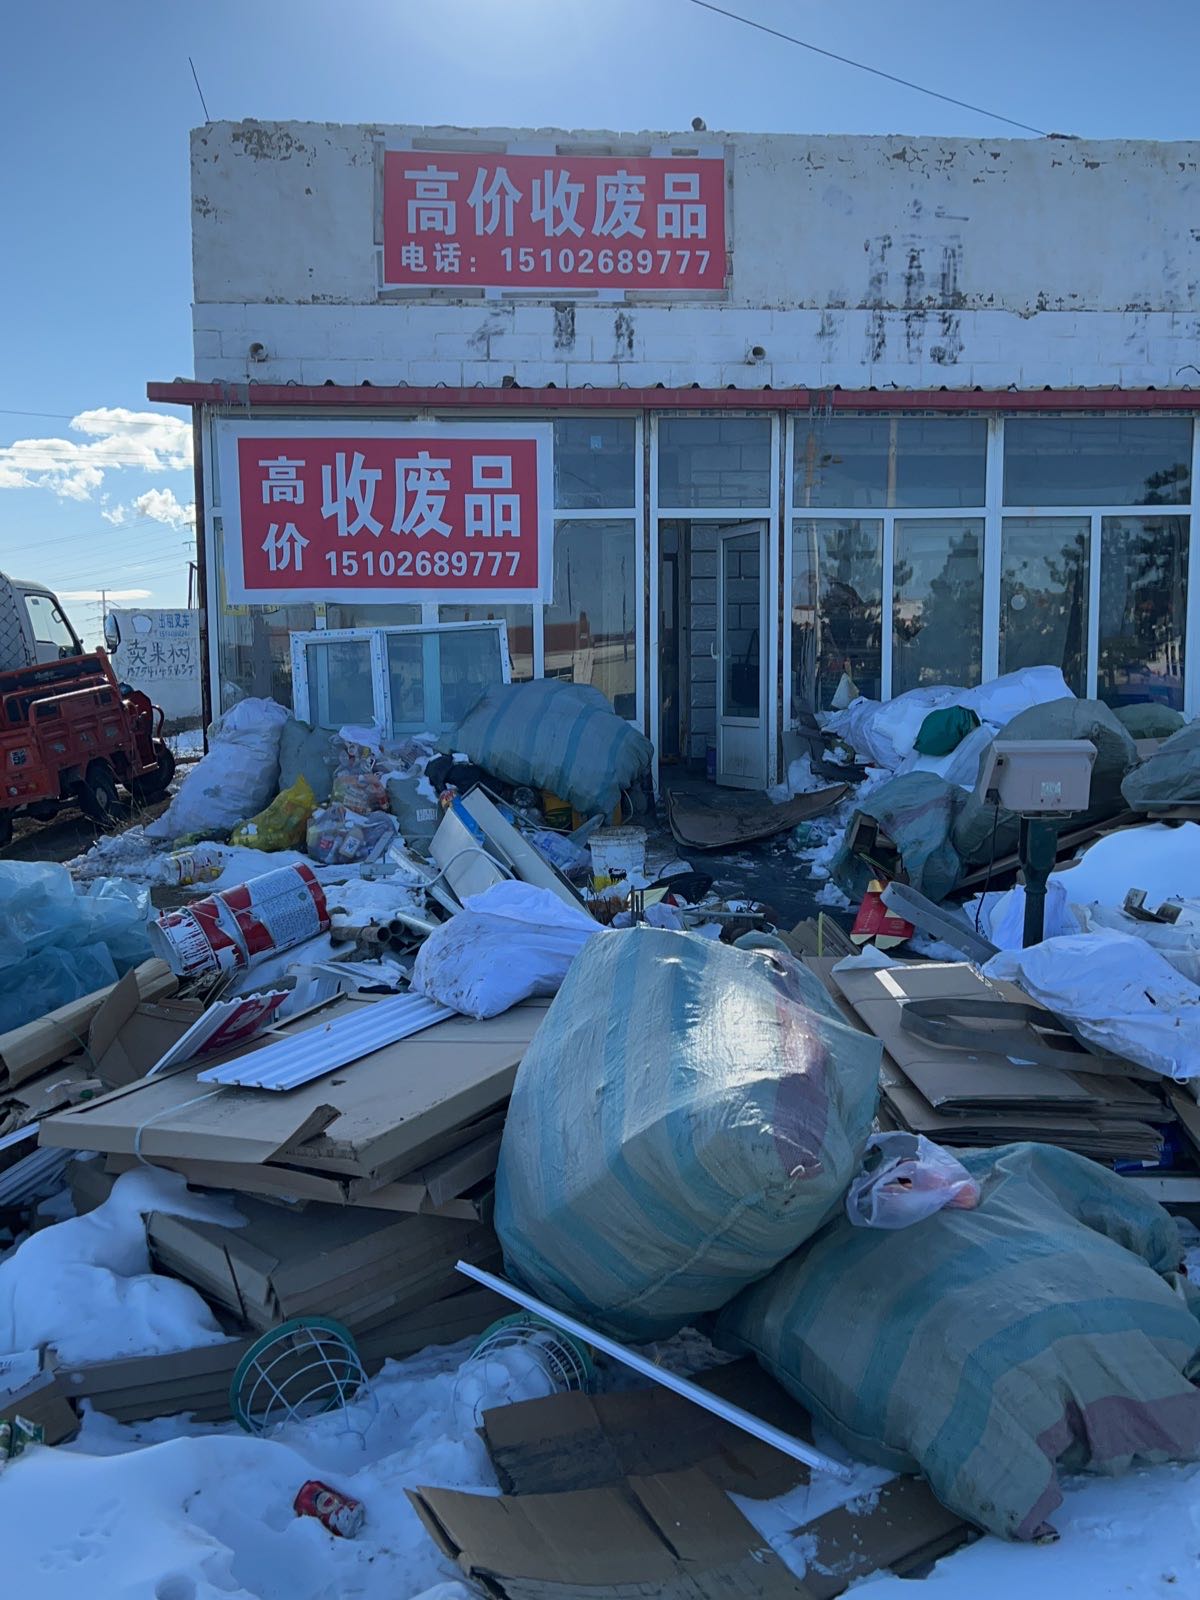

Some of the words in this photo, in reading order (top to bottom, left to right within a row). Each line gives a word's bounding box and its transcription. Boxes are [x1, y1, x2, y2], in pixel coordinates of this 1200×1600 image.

[404, 165, 707, 239] 高价收废品
[321, 451, 521, 539] 收废品
[325, 551, 521, 576] 15102689777
[127, 639, 190, 664] 卖果树
